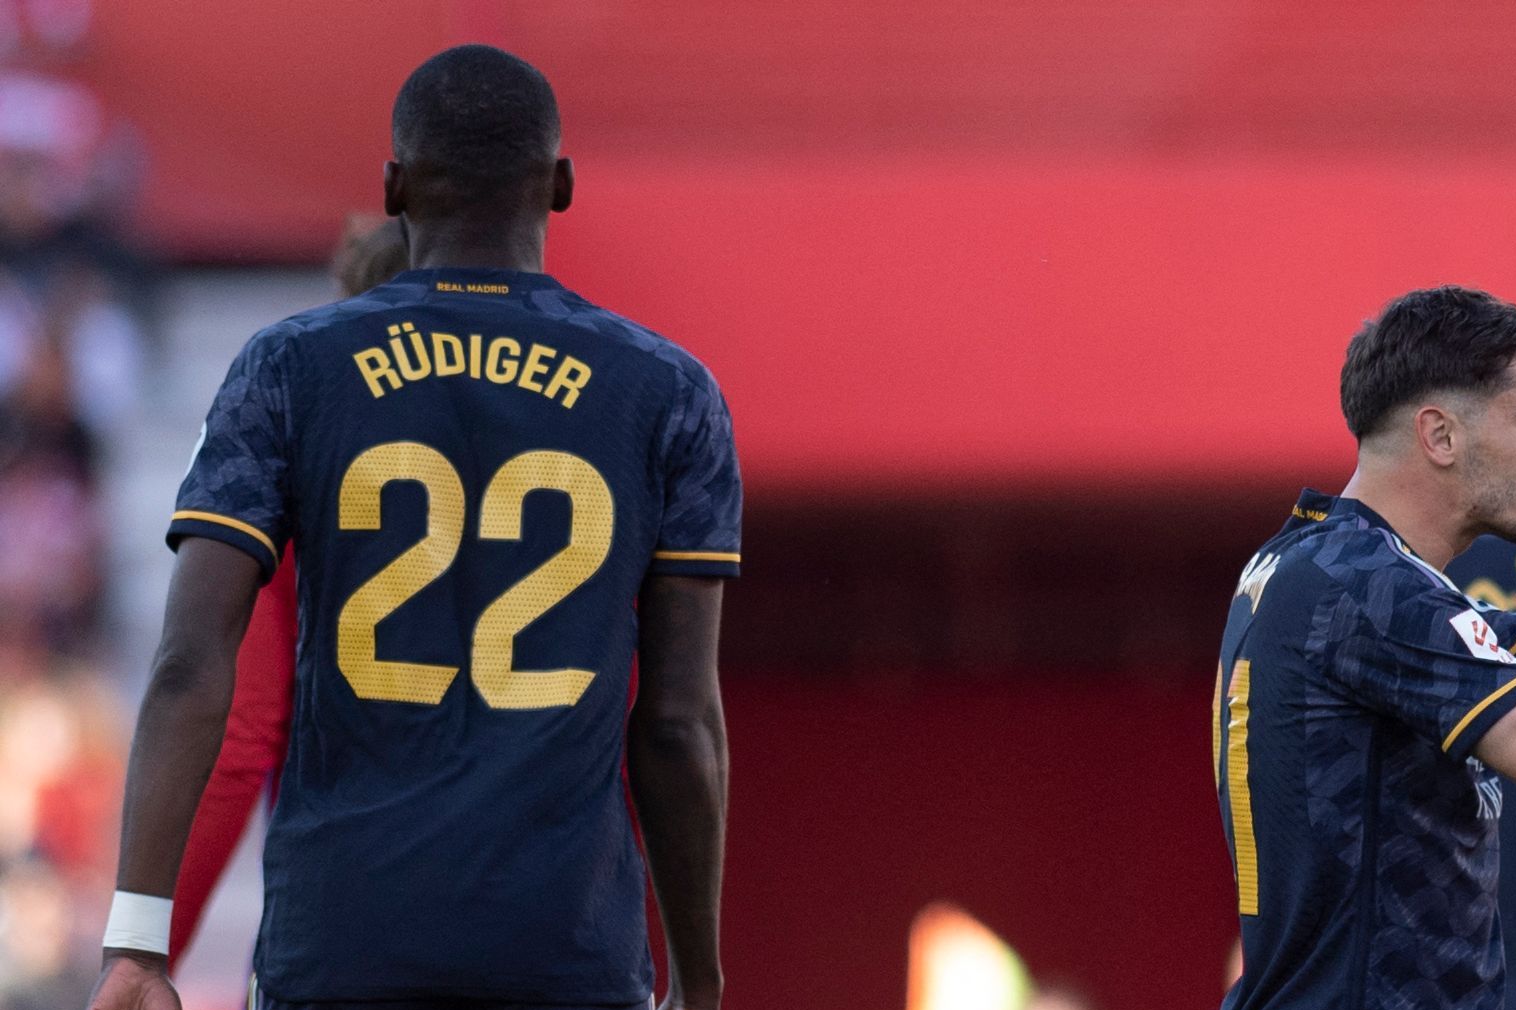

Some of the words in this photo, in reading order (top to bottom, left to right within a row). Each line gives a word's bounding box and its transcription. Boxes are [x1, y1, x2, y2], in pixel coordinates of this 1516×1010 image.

[436, 282, 465, 292] REAL
[466, 284, 509, 294] MADRID
[353, 321, 592, 410] RÜDIGER
[337, 440, 616, 711] 22
